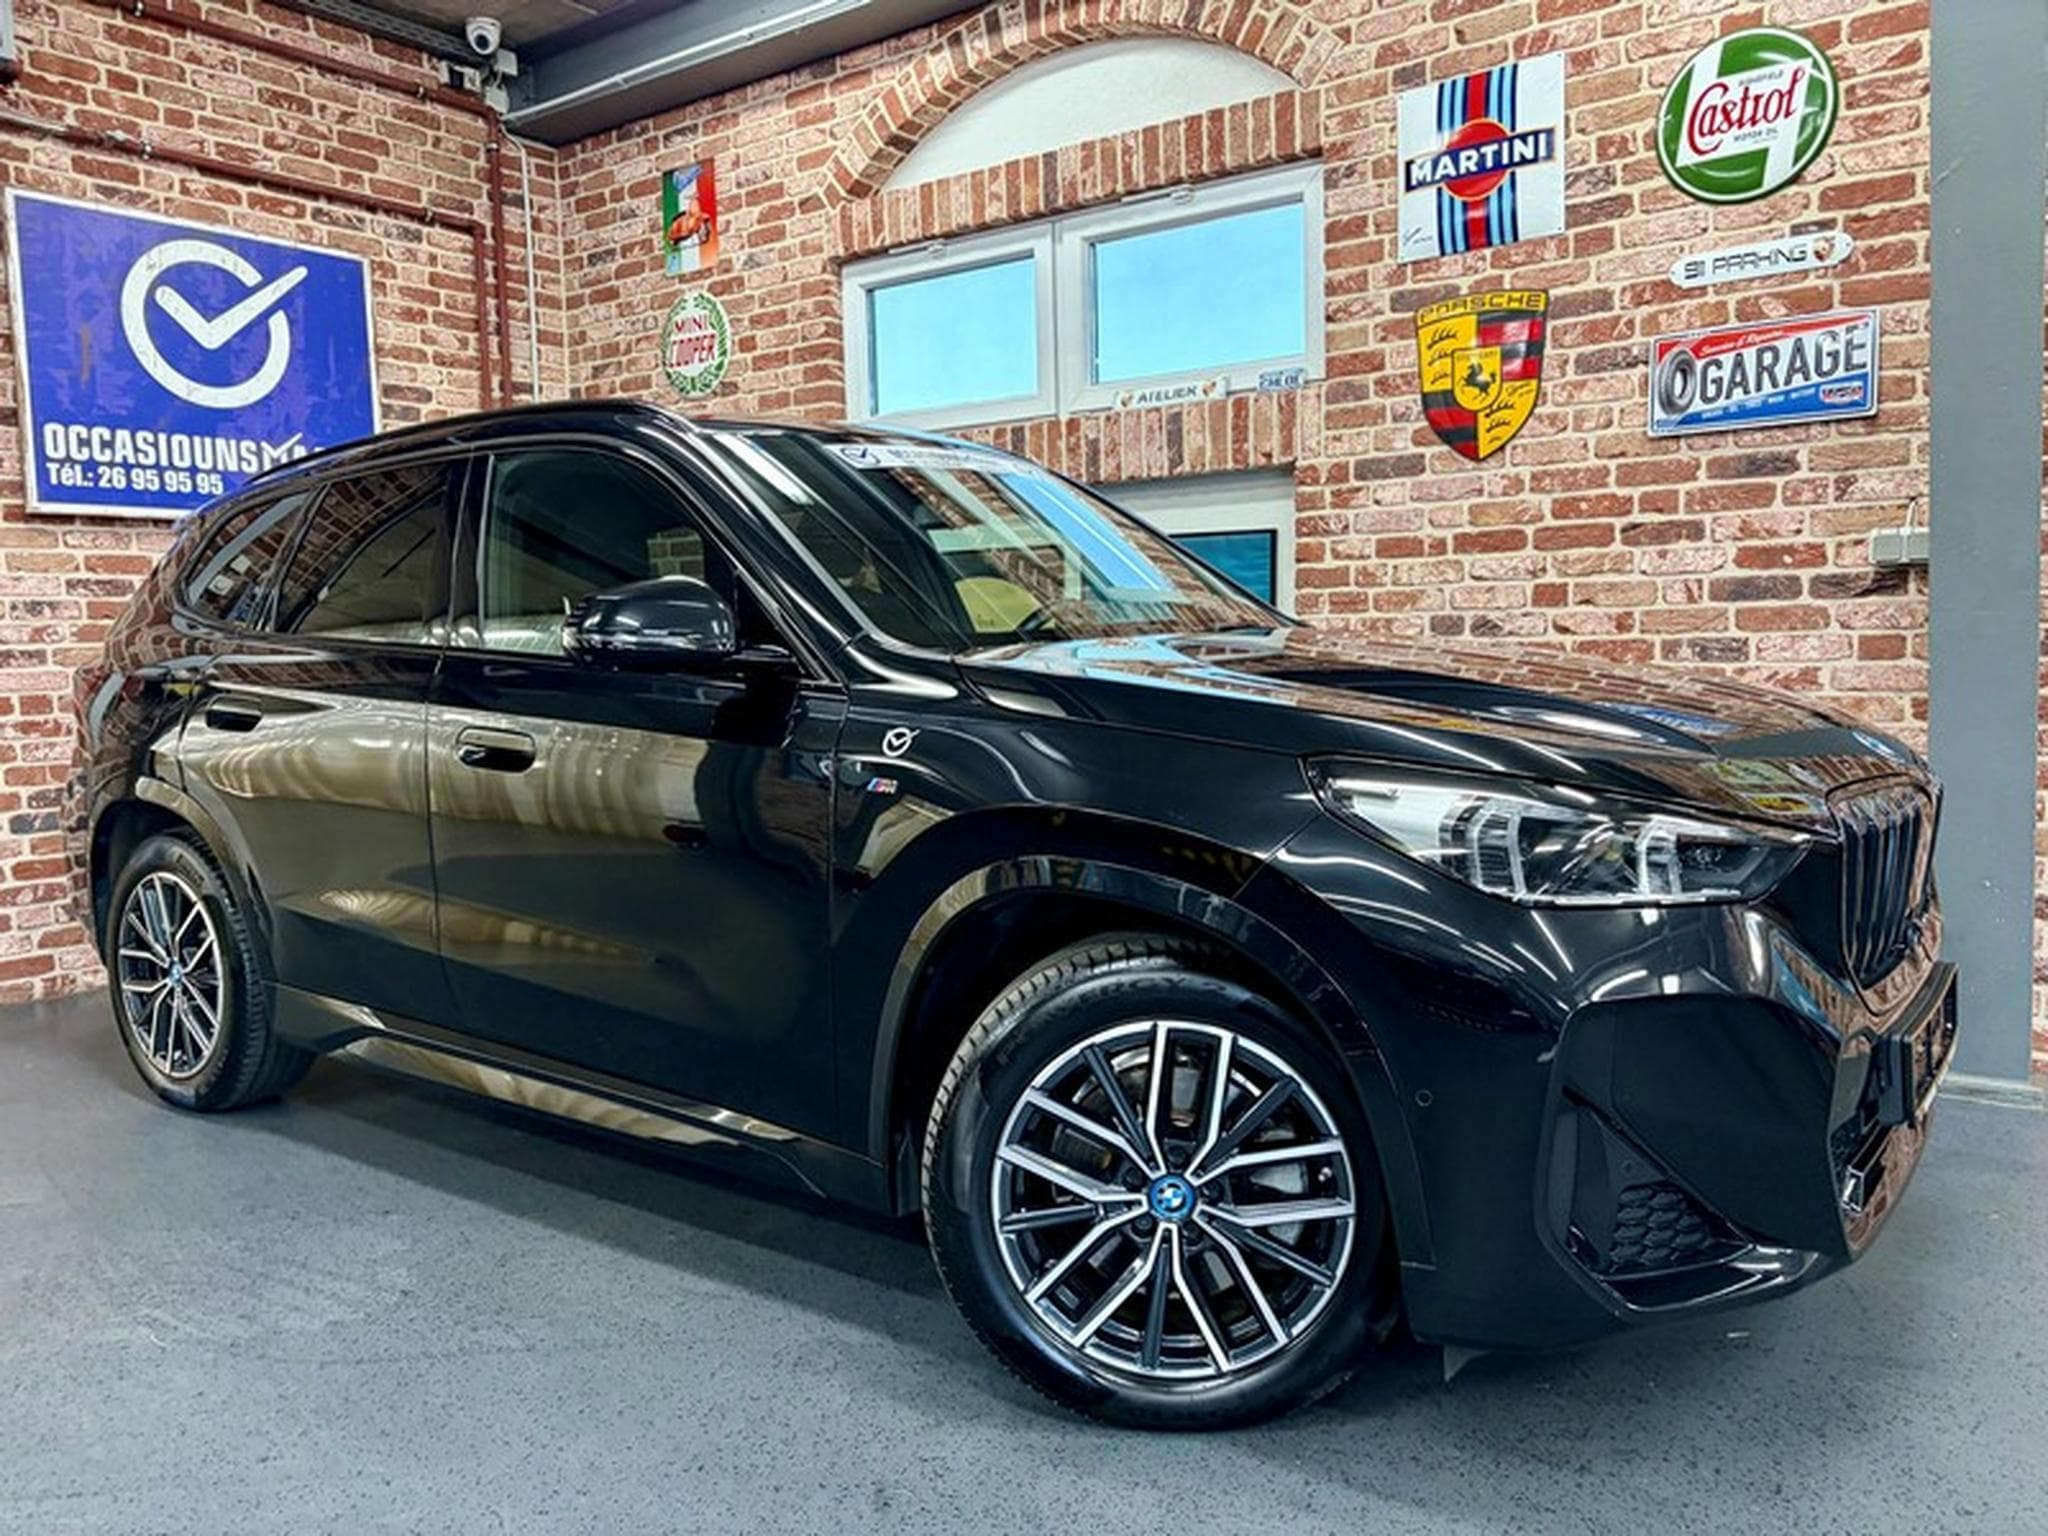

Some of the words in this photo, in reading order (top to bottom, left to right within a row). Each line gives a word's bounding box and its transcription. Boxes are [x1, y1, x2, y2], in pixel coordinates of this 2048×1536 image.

[1687, 65, 1806, 156] Castrol
[1408, 132, 1549, 187] MARTINI
[1712, 243, 1808, 274] PARKING
[674, 314, 708, 333] MINI
[1419, 291, 1544, 324] PORSCHE
[668, 333, 717, 368] COOPER
[1699, 322, 1870, 405] GARAGE
[46, 463, 93, 486] Tél.:
[97, 467, 126, 489] 26
[131, 471, 160, 491] 95
[164, 473, 193, 493] 95
[196, 475, 224, 495] 95
